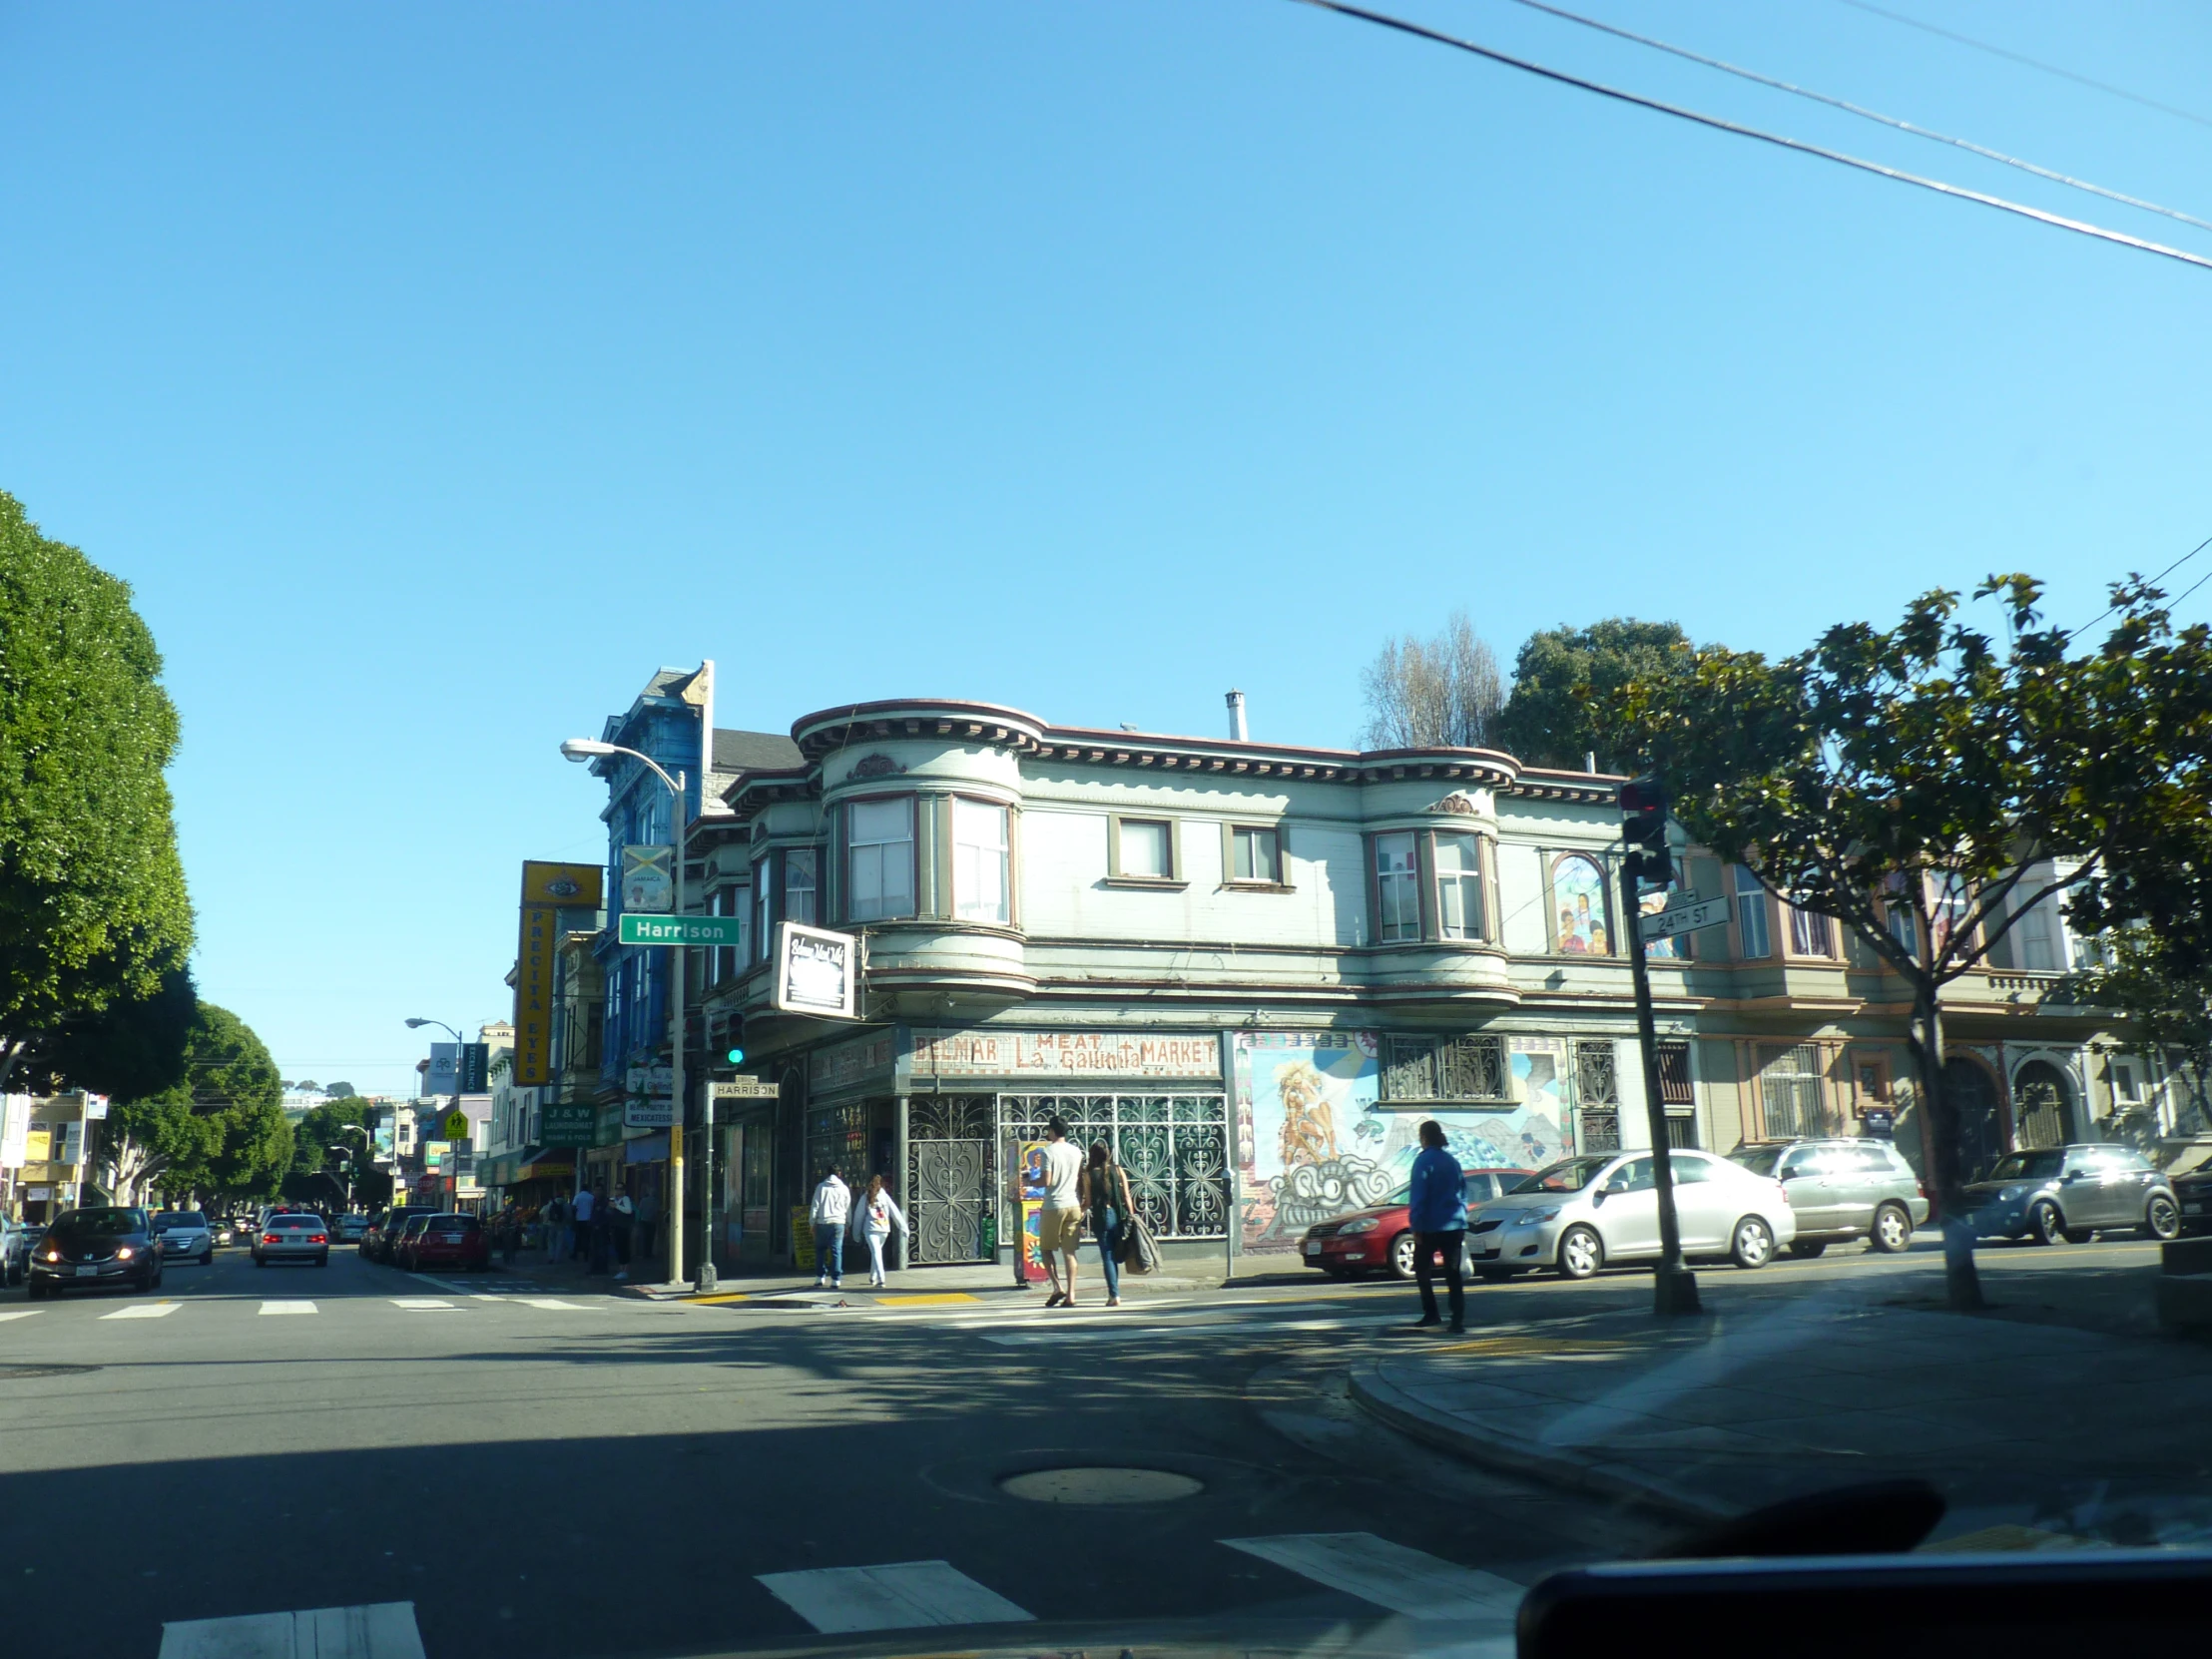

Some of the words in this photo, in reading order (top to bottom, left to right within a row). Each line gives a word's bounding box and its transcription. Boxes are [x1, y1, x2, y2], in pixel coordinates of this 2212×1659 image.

[637, 921, 724, 938] Harrison
[1657, 910, 1688, 932] 24TH
[1693, 905, 1709, 923] ST
[528, 911, 543, 1011] PRECITA
[525, 1022, 538, 1078] EYES
[914, 1036, 997, 1061] BELMAR
[1037, 1033, 1101, 1049] MEAT
[1140, 1039, 1215, 1068] MARKET
[467, 1046, 476, 1091] EXCELLENCE
[717, 1086, 776, 1095] HARRISON
[544, 1121, 594, 1130] LAUNDROMAT
[549, 1109, 557, 1118] J
[562, 1109, 572, 1118] &
[577, 1109, 590, 1118] W
